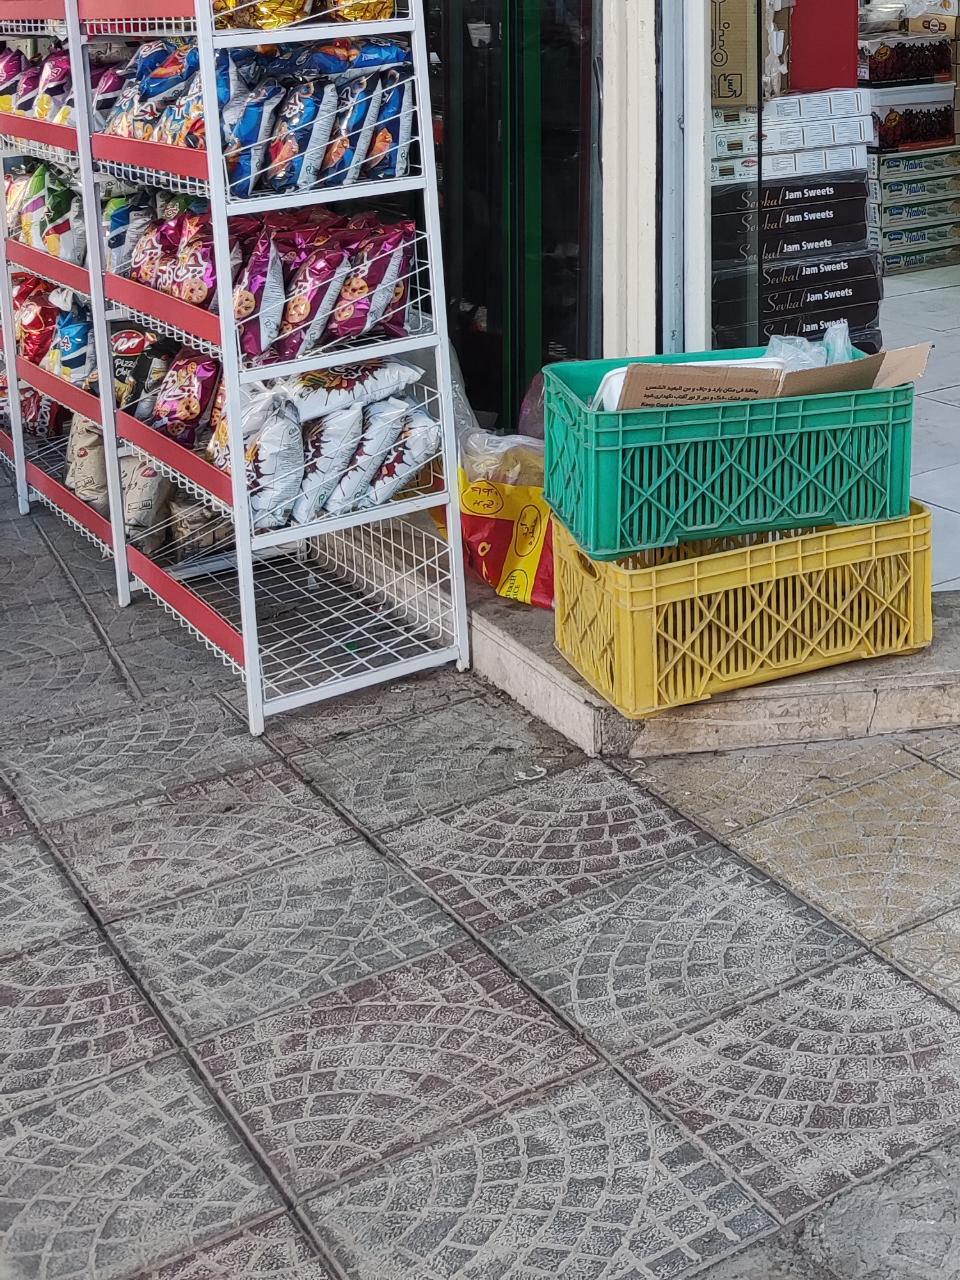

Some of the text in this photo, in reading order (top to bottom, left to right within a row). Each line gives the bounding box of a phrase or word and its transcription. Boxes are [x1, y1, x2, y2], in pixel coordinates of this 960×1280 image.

[785, 190, 802, 200] Jam
[803, 186, 835, 198] Sweets
[785, 214, 802, 224] Jam
[803, 210, 834, 221] Sweets
[783, 243, 800, 253] Jam
[802, 238, 832, 250] Sweets
[802, 266, 818, 276] Jam
[819, 261, 849, 273] Sweets
[806, 293, 823, 302] Jam
[824, 288, 853, 300] Sweets
[802, 322, 818, 333] Jam
